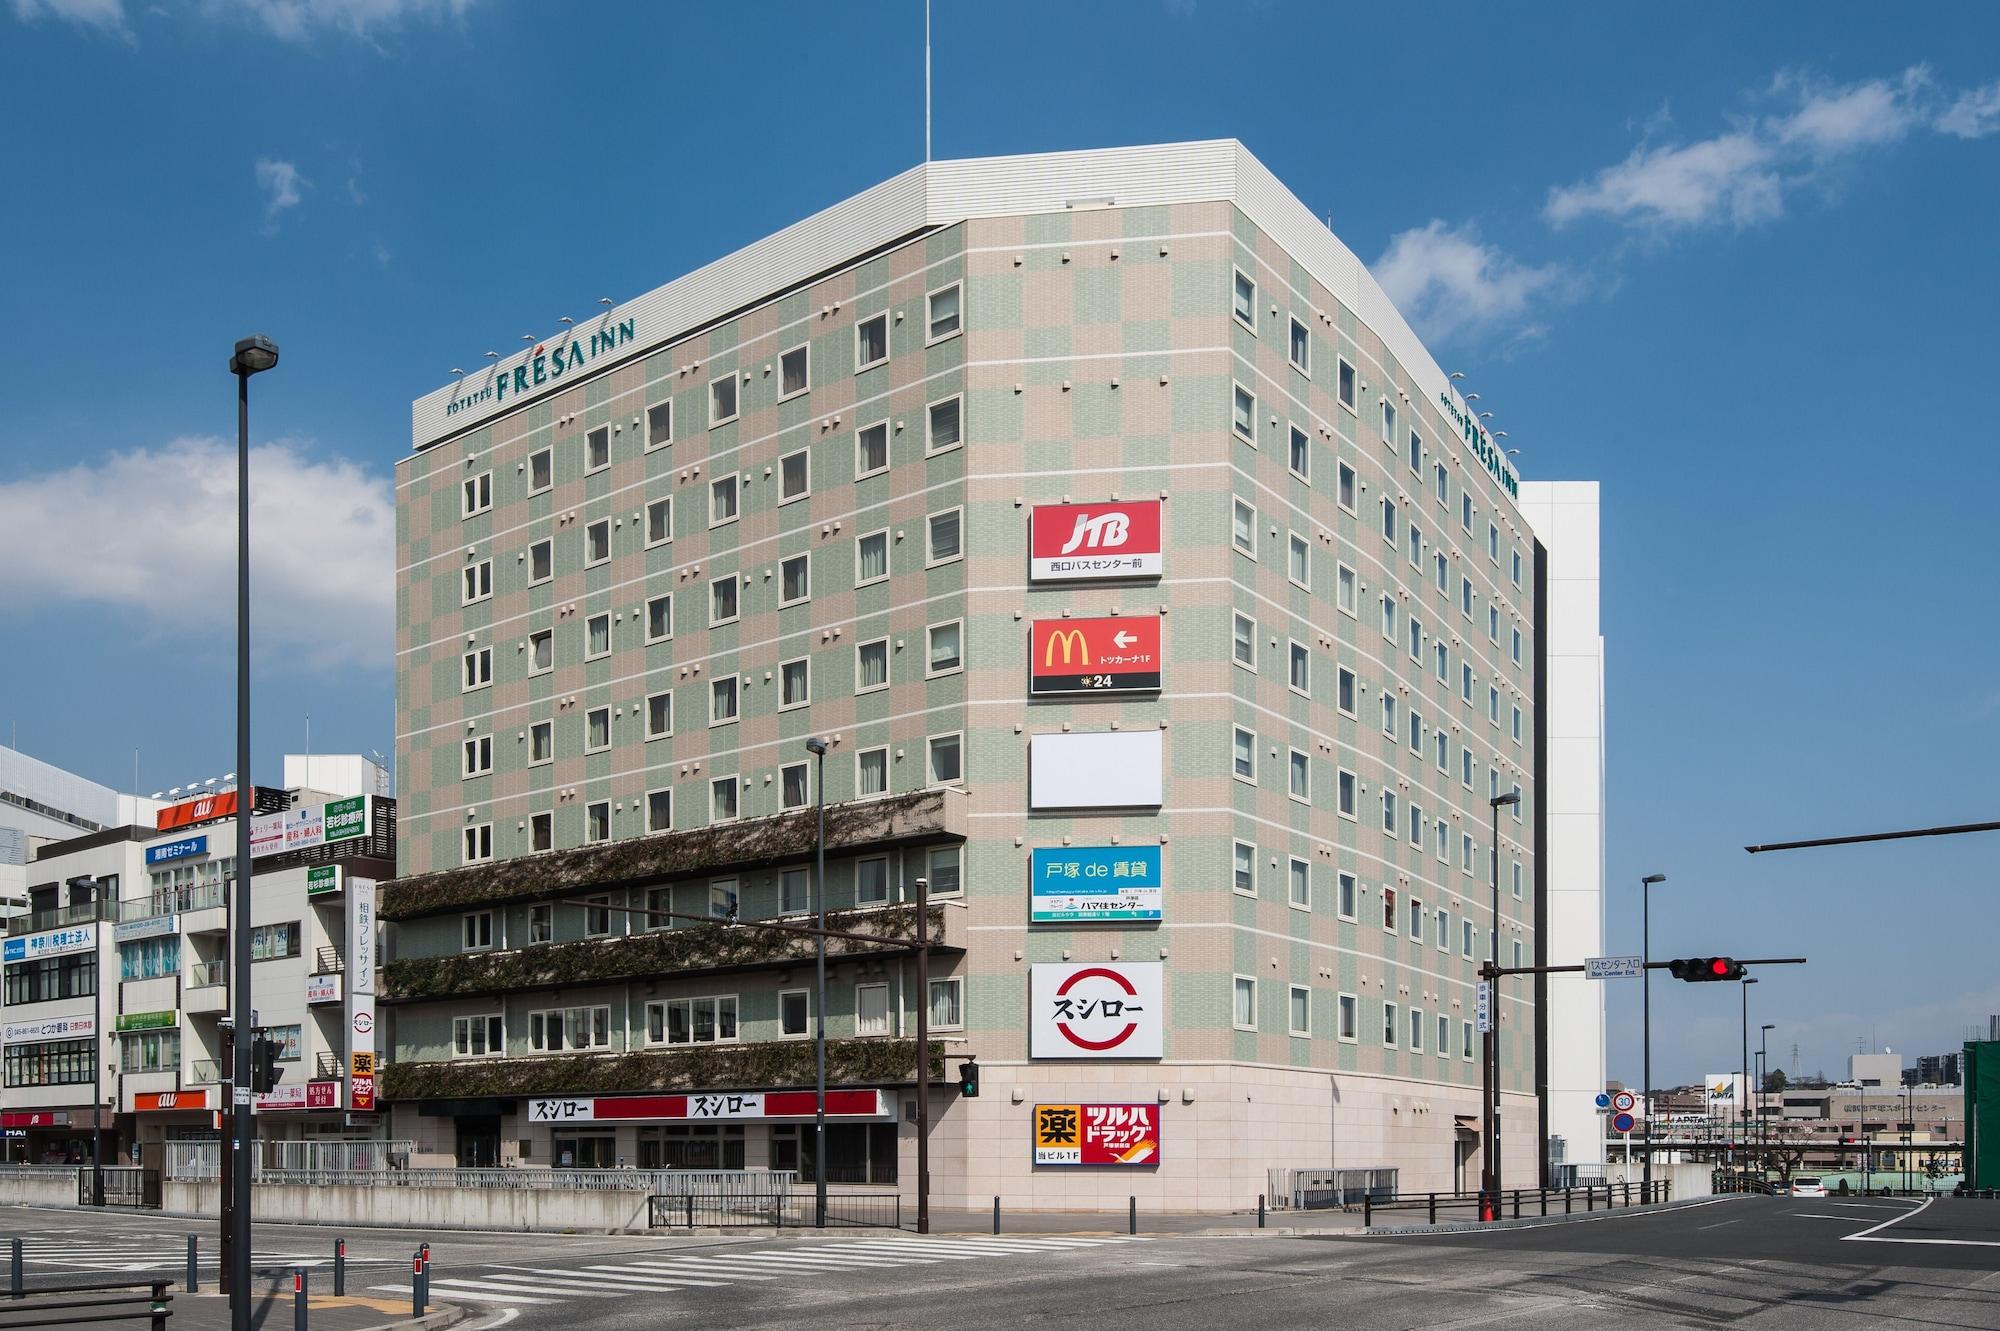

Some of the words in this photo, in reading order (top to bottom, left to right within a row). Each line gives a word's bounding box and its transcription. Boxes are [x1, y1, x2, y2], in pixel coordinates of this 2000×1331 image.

[446, 386, 493, 416] SOTETSU
[591, 318, 635, 359] INN
[1061, 512, 1130, 554] JTB
[1050, 558, 1142, 572] 西口バスセンター前
[1093, 675, 1113, 688] 24
[193, 800, 213, 817] au
[1046, 862, 1080, 879] 戸塚
[1085, 862, 1108, 877] de
[1113, 861, 1148, 878] 賃貸
[1081, 901, 1144, 910] ハマ住センター
[31, 928, 91, 950] 神奈川税理士法人
[359, 901, 369, 988] 相鉄フレッサイン
[1587, 959, 1640, 971] バスセンター入口
[1051, 998, 1144, 1021] スシロー
[353, 1019, 374, 1027] スシロー
[354, 1054, 372, 1073] 薬
[309, 1086, 332, 1096] 処方せん
[352, 1078, 373, 1087] ツルハ
[352, 1085, 374, 1096] ドラッグ
[158, 1093, 177, 1108] au
[315, 1095, 327, 1105] 受付
[1618, 1097, 1630, 1107] 30
[1710, 1092, 1734, 1100] APITA
[535, 1100, 589, 1121] スシロー
[693, 1095, 758, 1118] スシロー
[1086, 1107, 1150, 1127] ツルハ
[1040, 1108, 1077, 1144] 薬
[1086, 1125, 1152, 1144] ドラッグ
